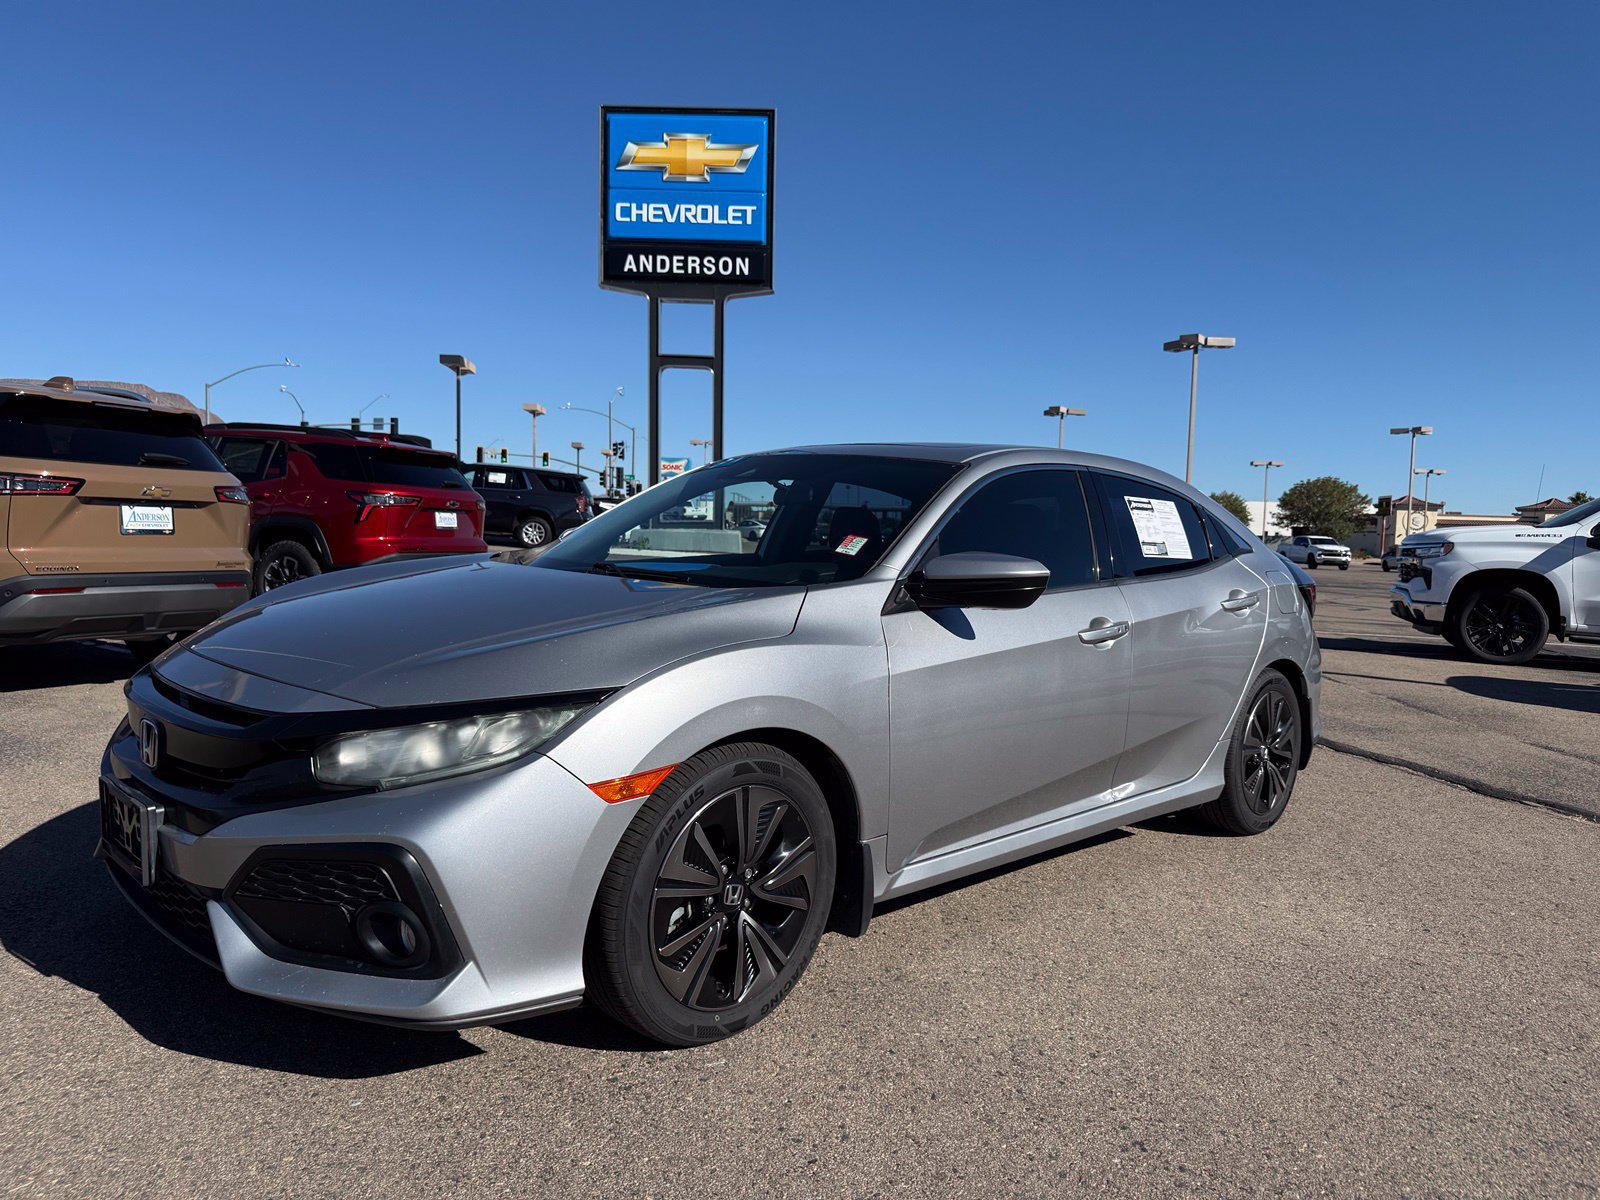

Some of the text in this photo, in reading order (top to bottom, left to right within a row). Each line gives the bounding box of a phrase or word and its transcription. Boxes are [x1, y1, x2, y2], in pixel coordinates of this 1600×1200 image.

[615, 202, 757, 225] CHEVROLET
[623, 254, 750, 275] ANDERSON
[661, 463, 683, 471] SONIC
[125, 511, 170, 527] ANDERSON
